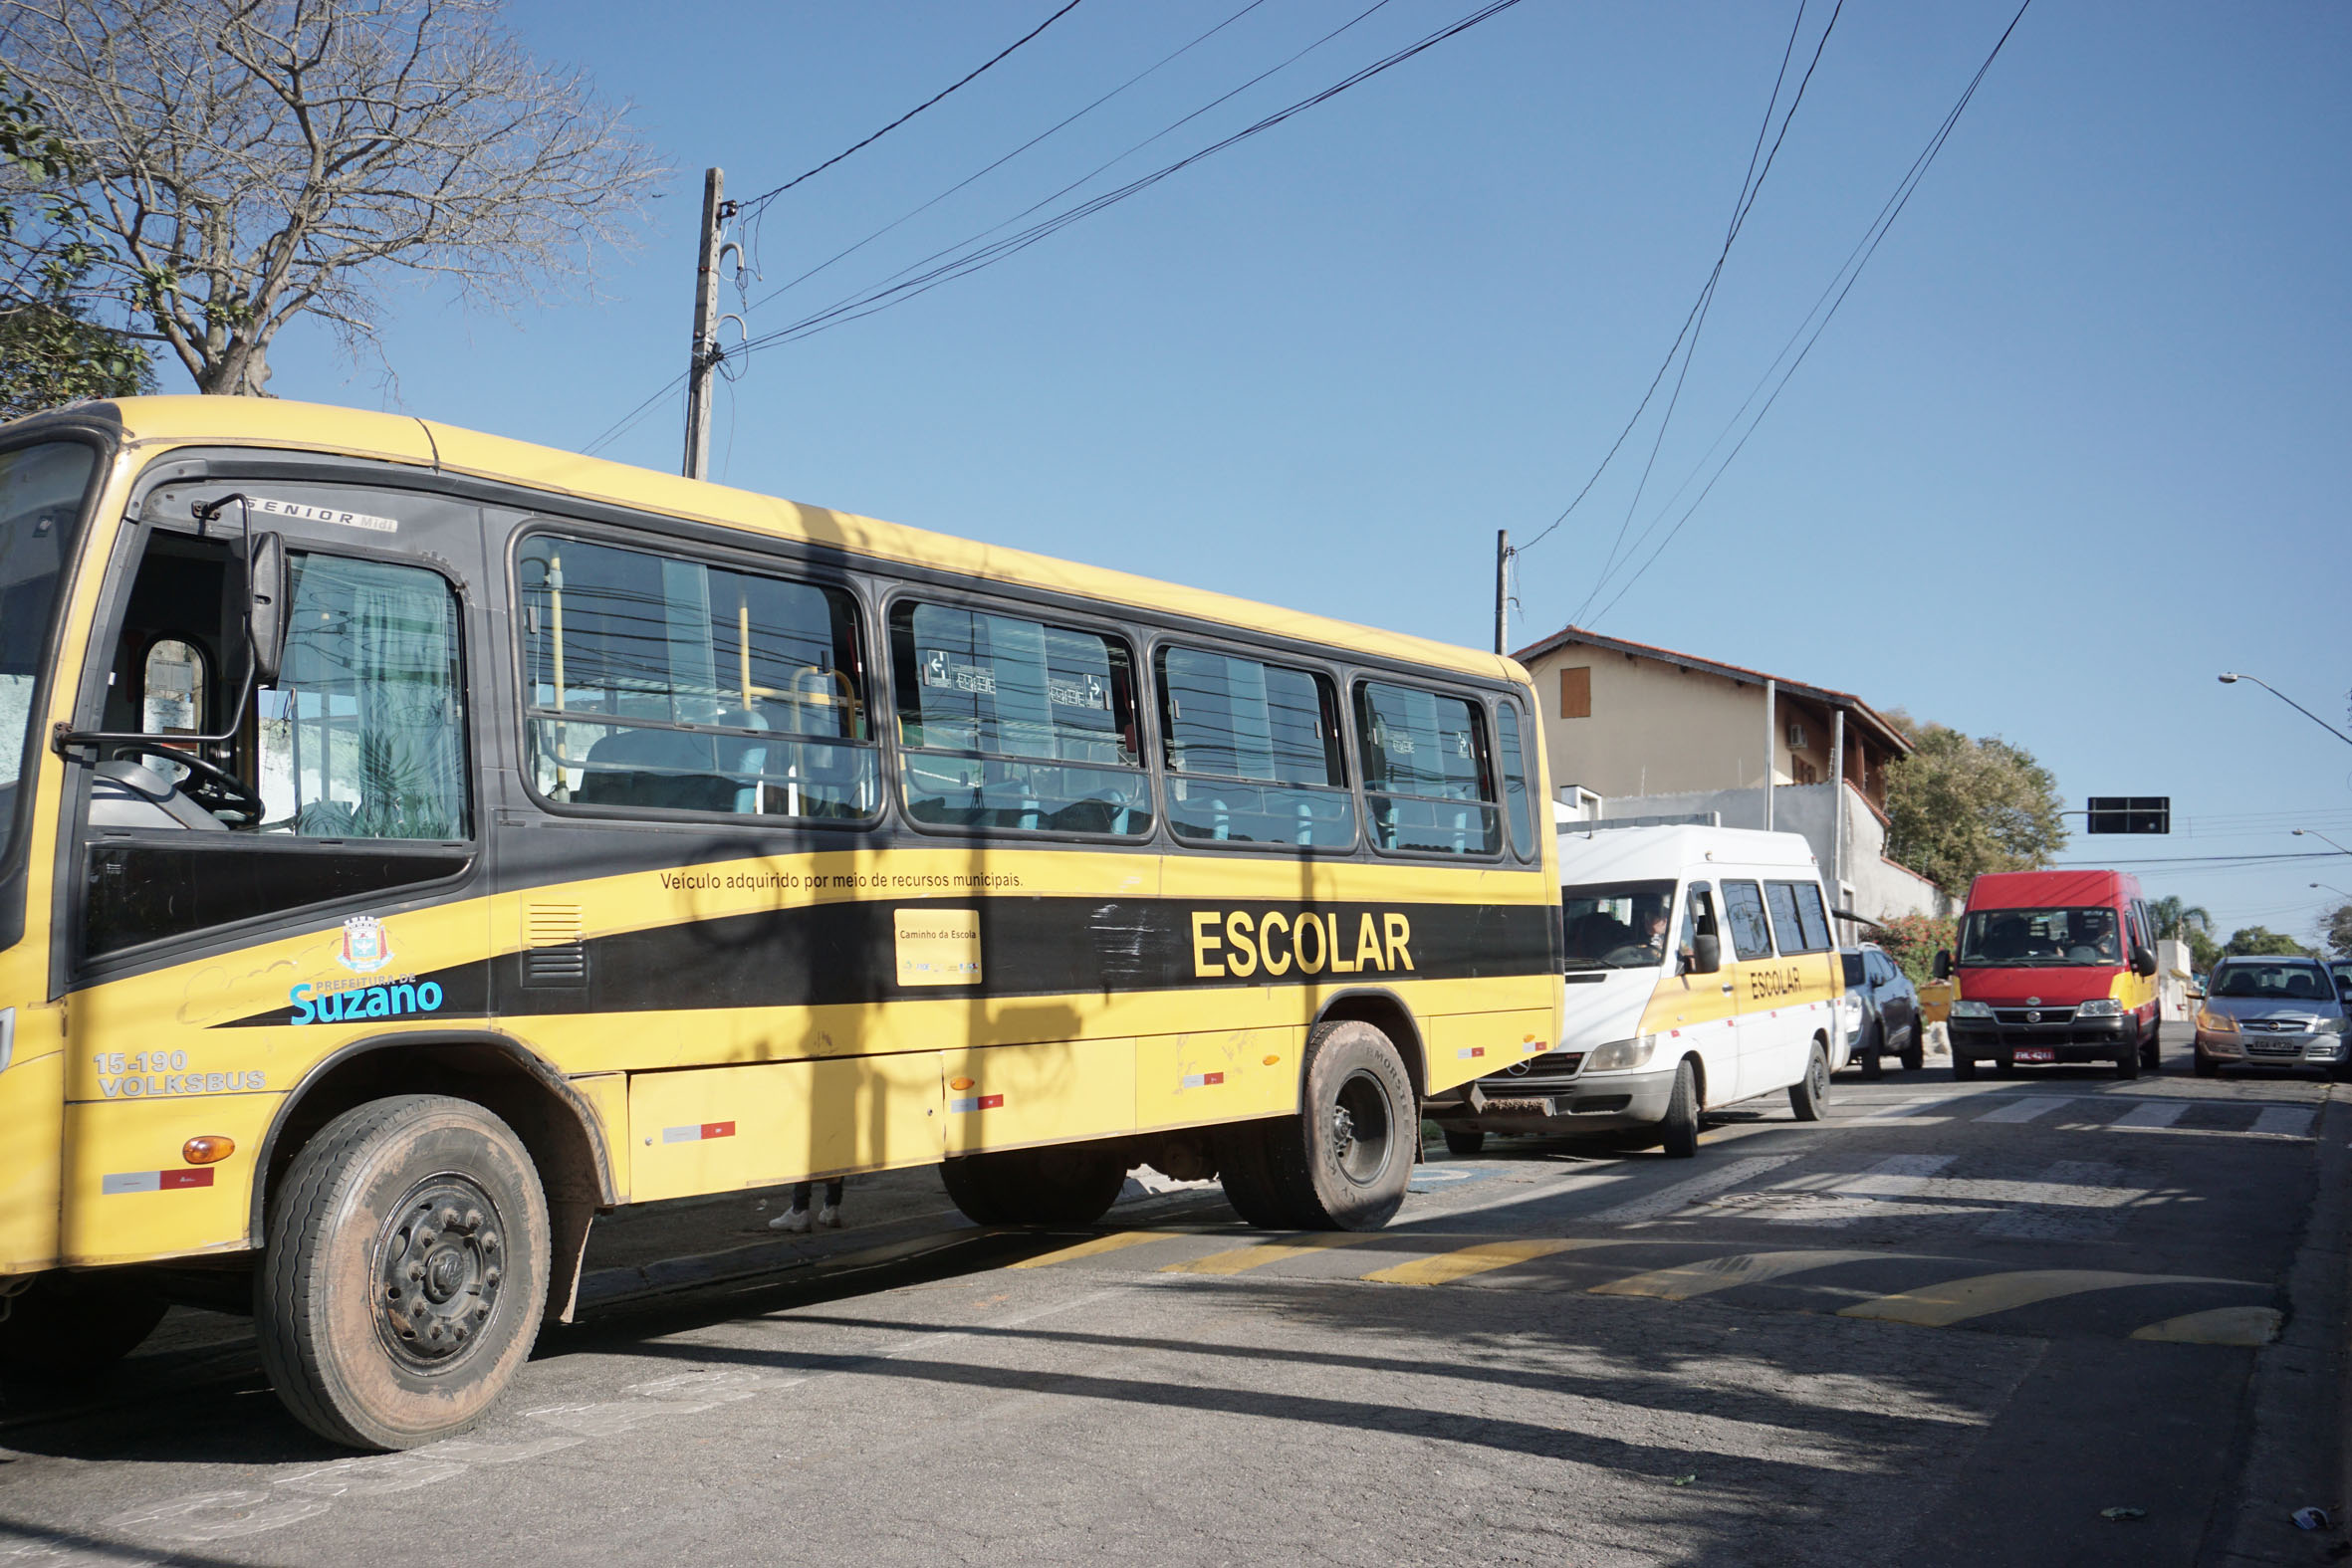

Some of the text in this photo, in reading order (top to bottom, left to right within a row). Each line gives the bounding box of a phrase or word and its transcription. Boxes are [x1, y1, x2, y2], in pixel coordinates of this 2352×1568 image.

[246, 499, 394, 531] SENIOR Midi
[660, 872, 1024, 892] Veículo adquirido por meio de recursos municipais.
[899, 930, 977, 939] Caminho da Escola
[1191, 910, 1415, 978] ESCOLAR
[316, 973, 416, 992] PREFEITURA DE
[1750, 967, 1801, 1000] ESCOLAR
[289, 982, 444, 1026] Suzano
[94, 1049, 187, 1075] 15-190
[99, 1070, 266, 1098] VOLKSBUS
